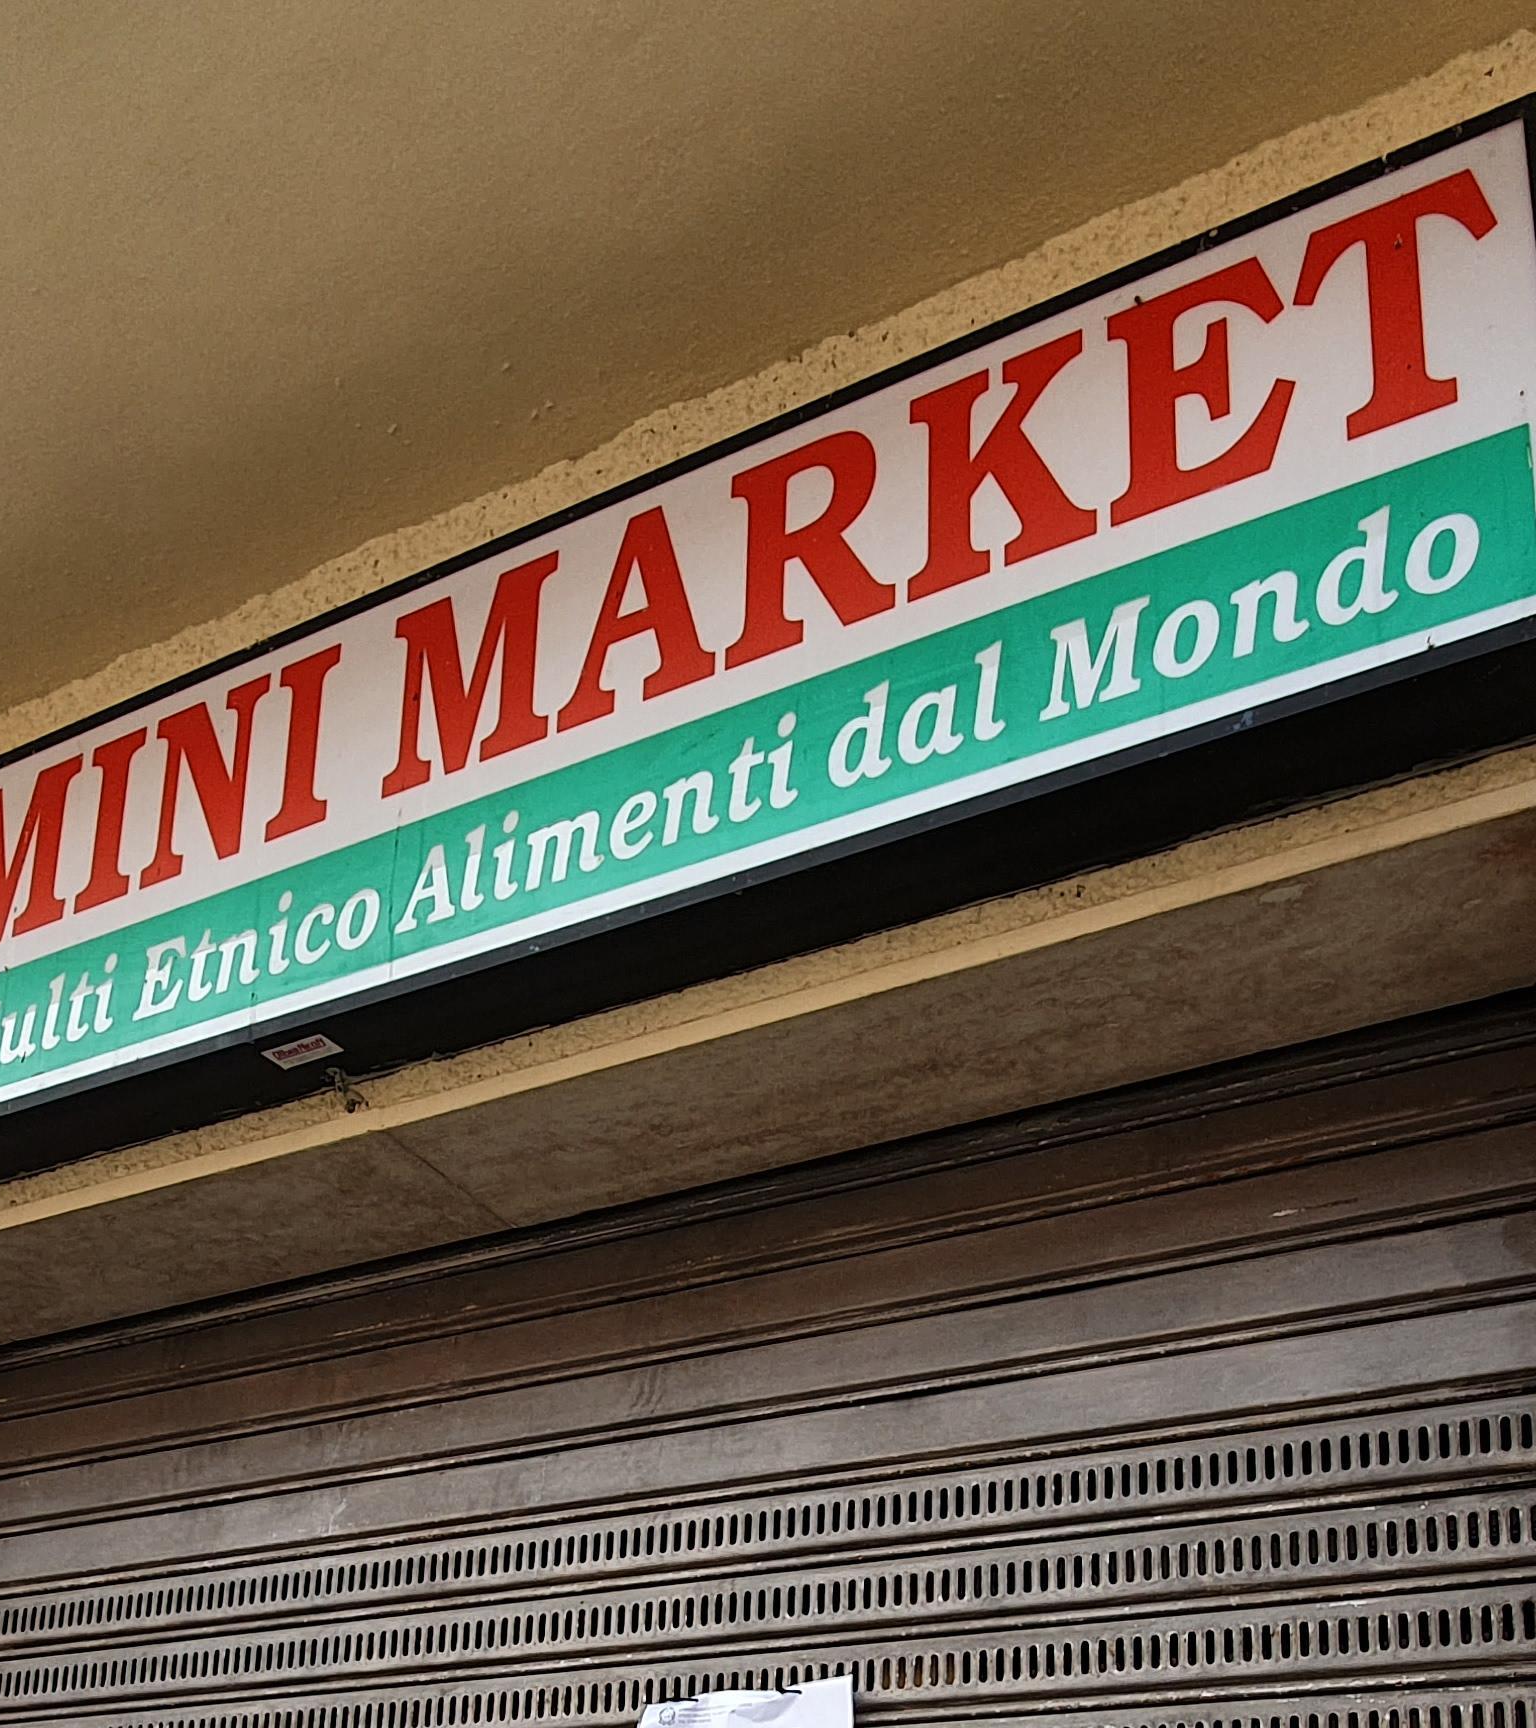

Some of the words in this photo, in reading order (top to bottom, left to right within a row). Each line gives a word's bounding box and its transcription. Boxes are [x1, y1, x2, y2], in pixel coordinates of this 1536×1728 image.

[133, 888, 380, 1021] Etnico
[394, 712, 797, 934] Alimenti
[827, 647, 1006, 789] dal
[1038, 504, 1481, 722] Mondo
[382, 168, 1498, 798] MARKET
